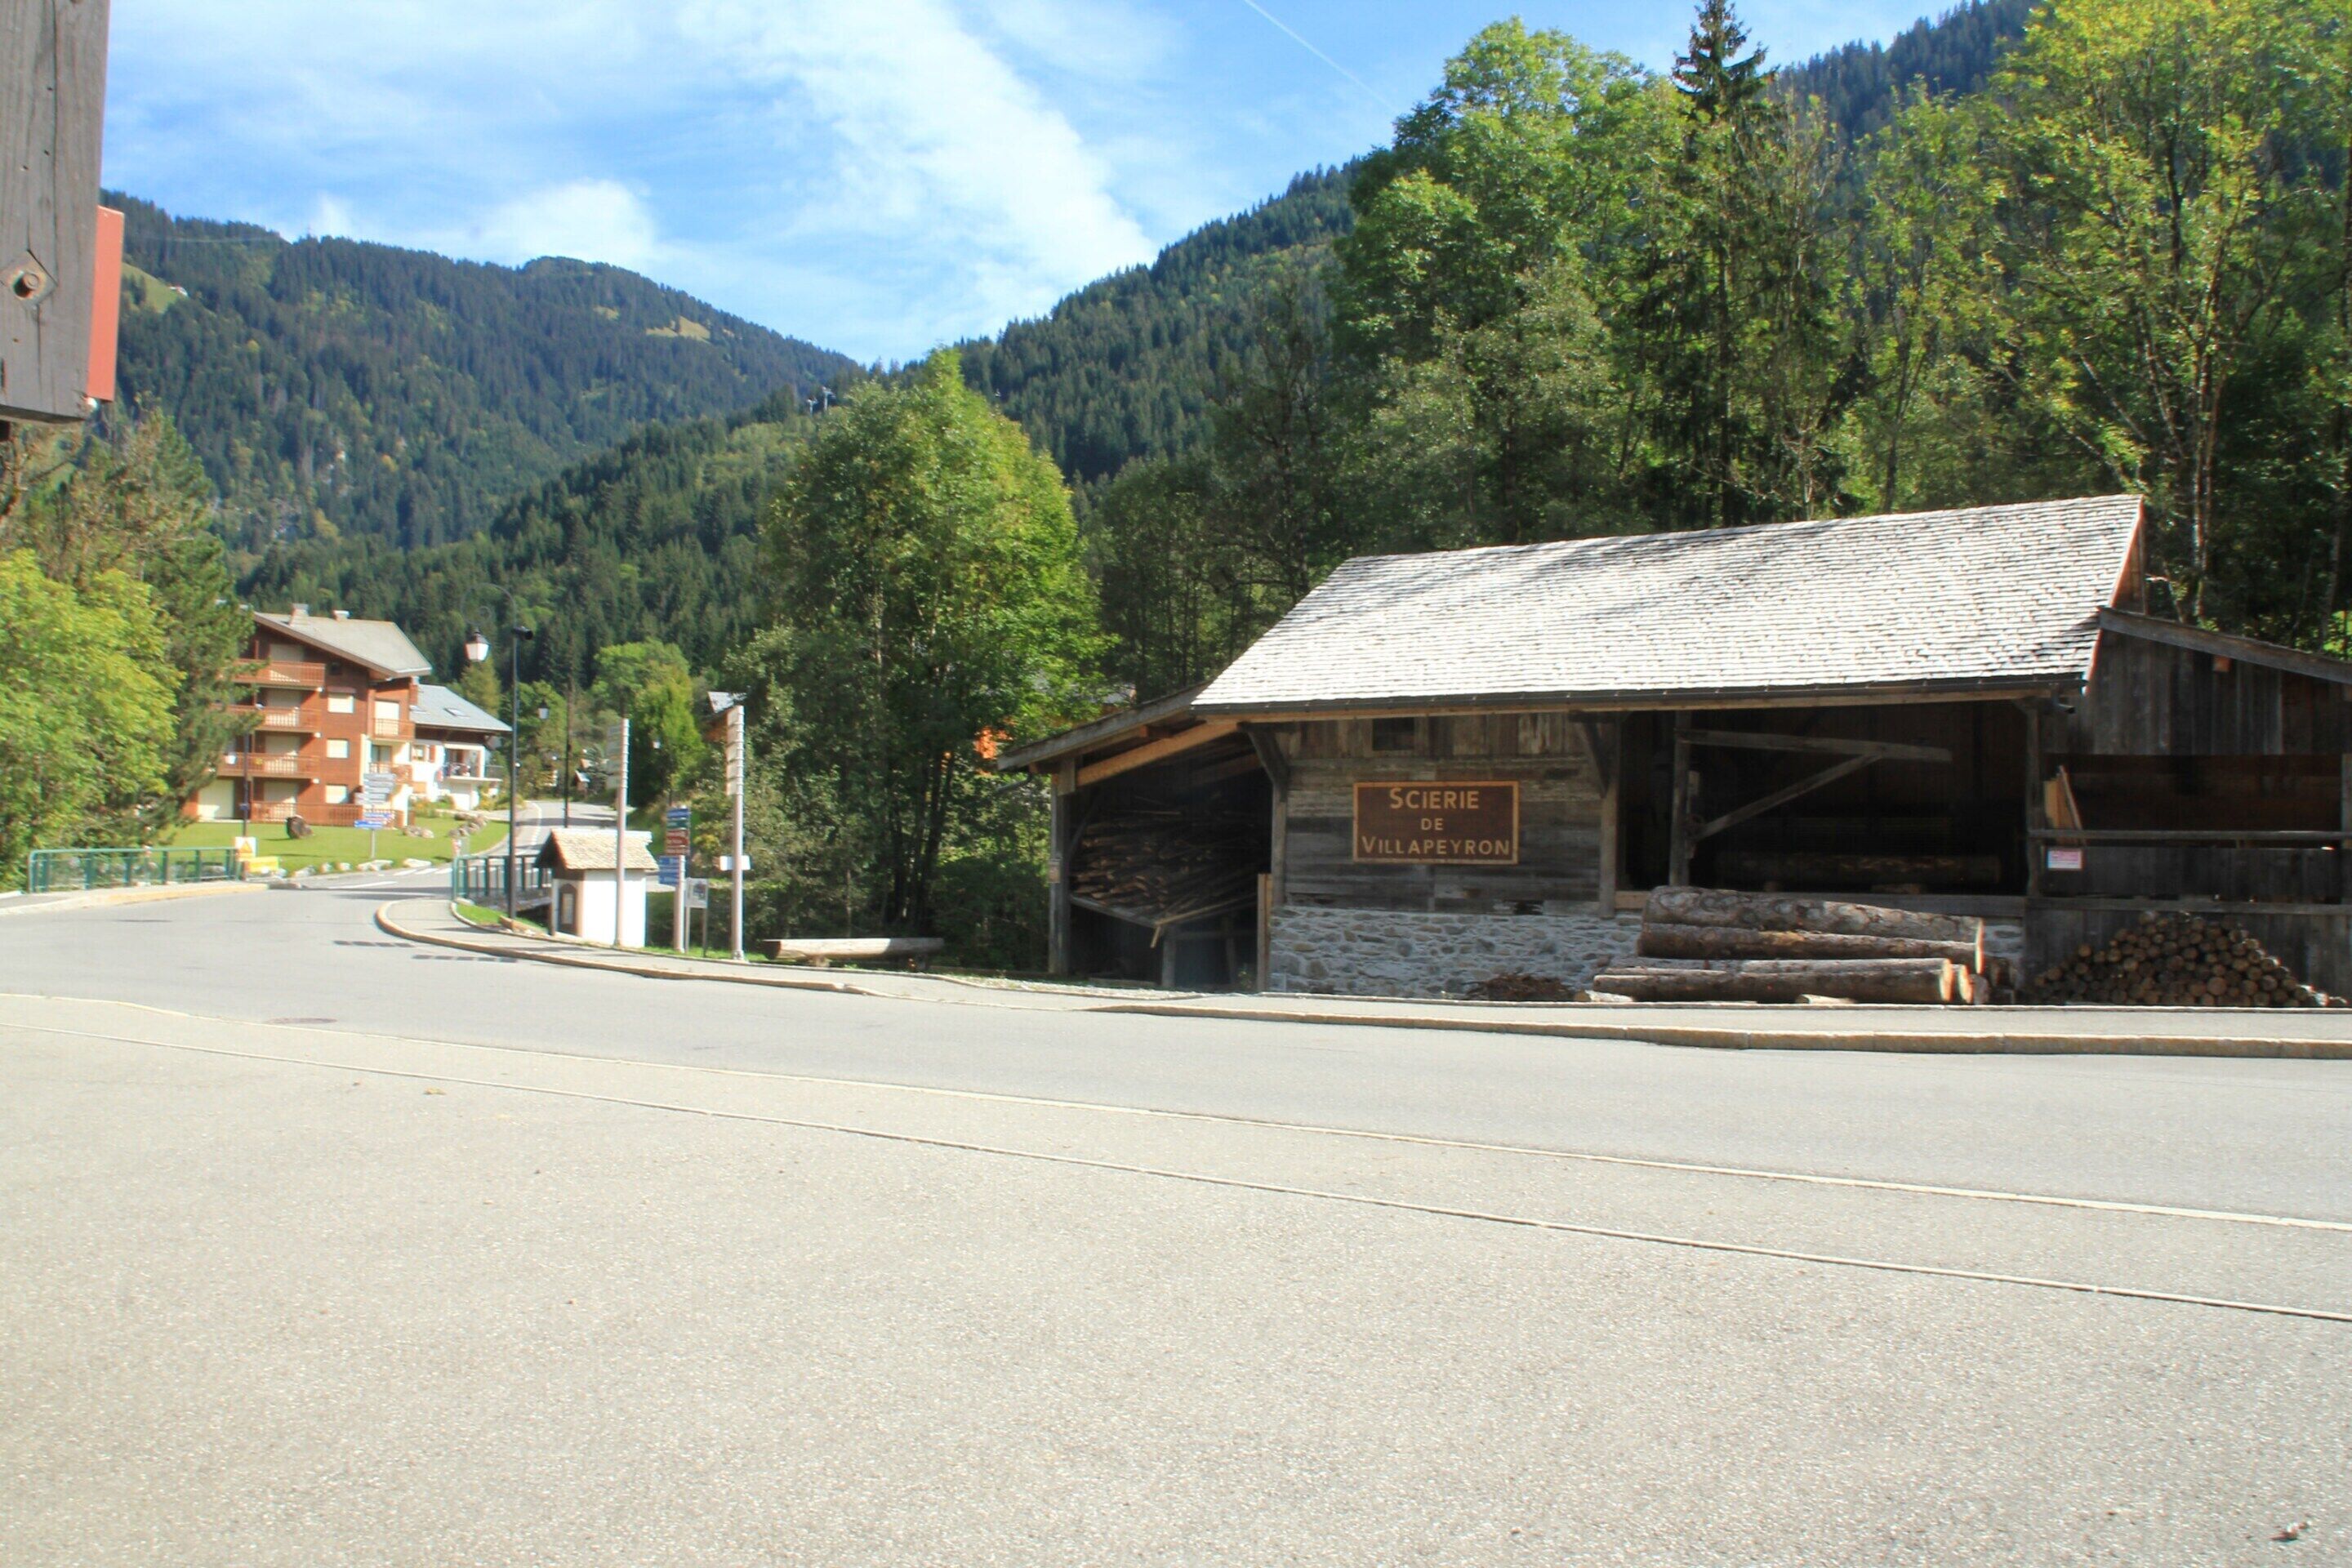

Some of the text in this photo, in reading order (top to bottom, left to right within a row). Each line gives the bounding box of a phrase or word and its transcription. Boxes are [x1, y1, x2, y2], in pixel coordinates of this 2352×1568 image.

[1389, 787, 1479, 809] SCIERIE
[1421, 817, 1444, 831] DE
[1361, 835, 1510, 855] VILLAPEYRON
